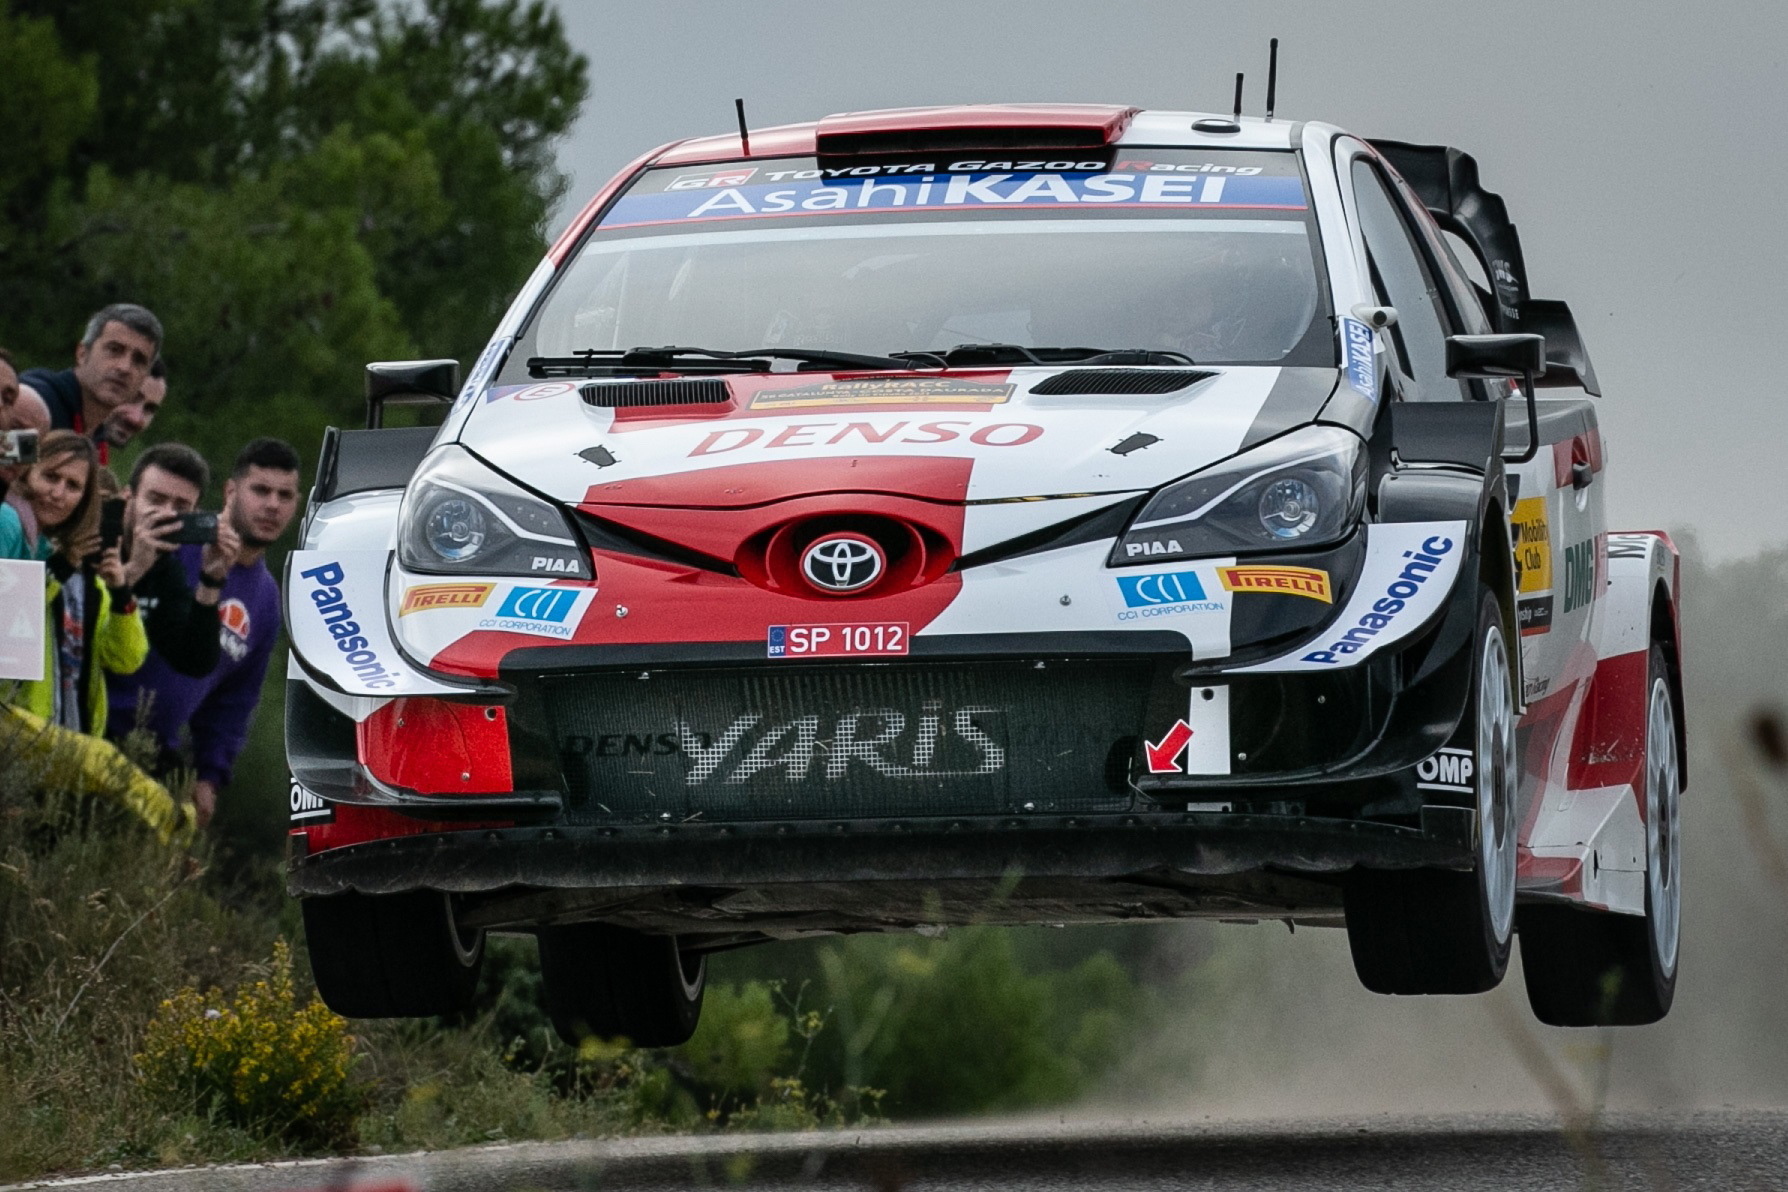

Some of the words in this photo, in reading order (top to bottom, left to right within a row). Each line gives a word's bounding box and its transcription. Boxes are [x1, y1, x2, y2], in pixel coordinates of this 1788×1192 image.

[672, 174, 747, 189] GR
[765, 164, 935, 182] TOYOTA
[948, 160, 1106, 171] GAZOO
[1116, 160, 1263, 176] Racing
[687, 421, 1044, 457] DENSO
[1126, 540, 1183, 556] PIAA
[1524, 547, 1541, 571] Club
[531, 557, 579, 573] PIAA
[1564, 538, 1593, 613] DMG
[1226, 570, 1324, 595] PIRELLI
[404, 585, 488, 611] PIRELLI
[1300, 535, 1453, 665] Panasonic
[1117, 611, 1138, 621] CCI
[1141, 602, 1224, 618] CORPORATION
[300, 561, 398, 689] Panasonic
[479, 619, 495, 627] CCI
[499, 620, 572, 636] CORPORATION
[769, 646, 785, 654] EST
[790, 628, 830, 652] SP
[842, 626, 902, 651] 1012
[1417, 755, 1473, 784] OMP
